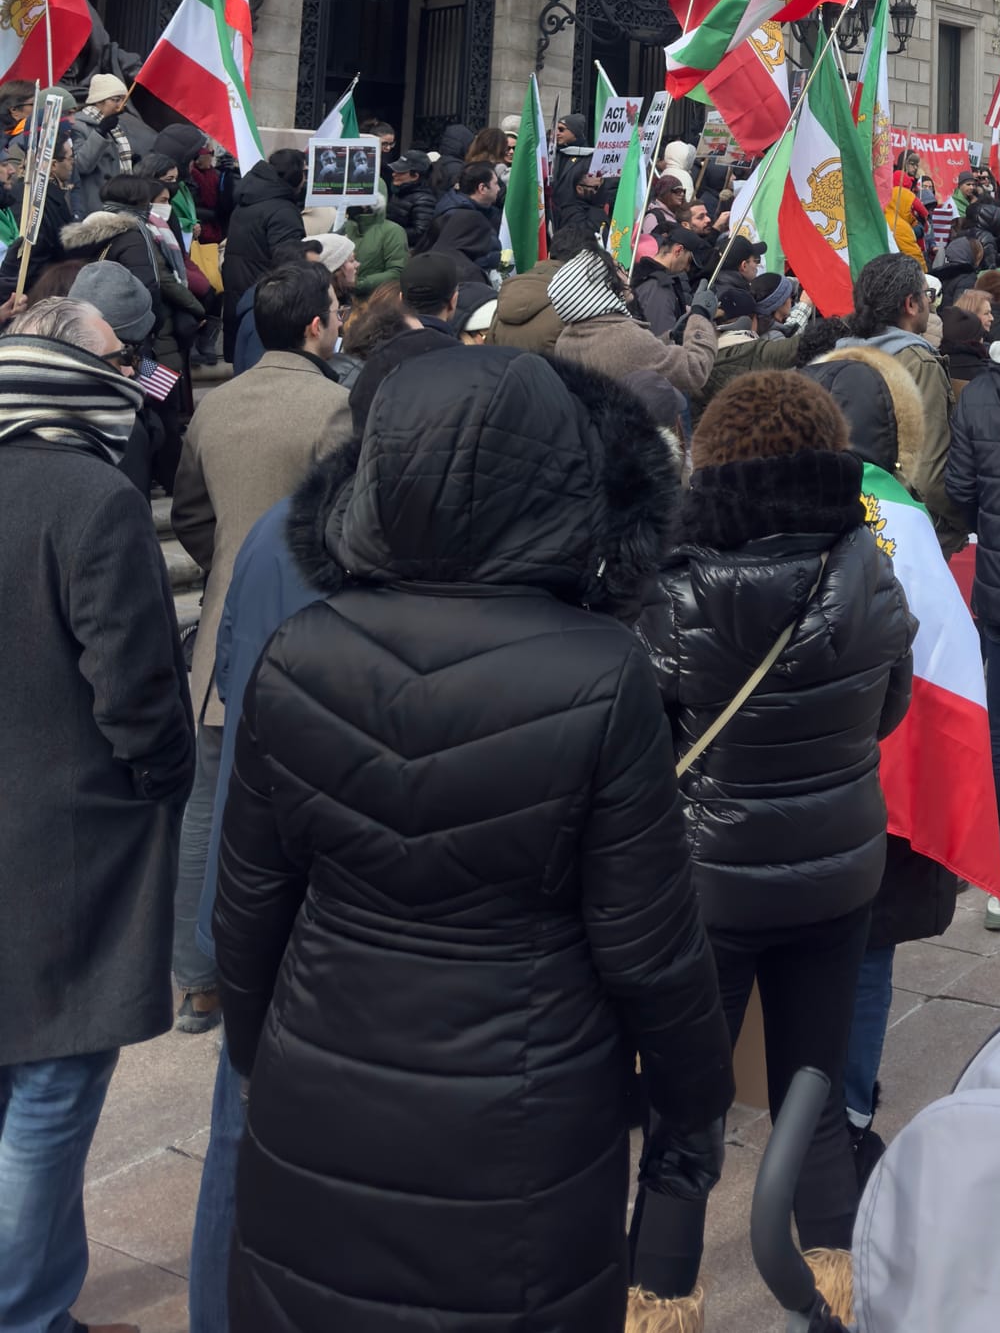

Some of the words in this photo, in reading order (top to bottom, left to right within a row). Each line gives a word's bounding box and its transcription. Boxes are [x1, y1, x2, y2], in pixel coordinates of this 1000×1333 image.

[605, 107, 625, 119] ACT
[602, 121, 627, 133] NOW
[889, 132, 907, 148] EZA
[910, 136, 968, 152] PAHLAVI
[602, 154, 621, 164] IRAN
